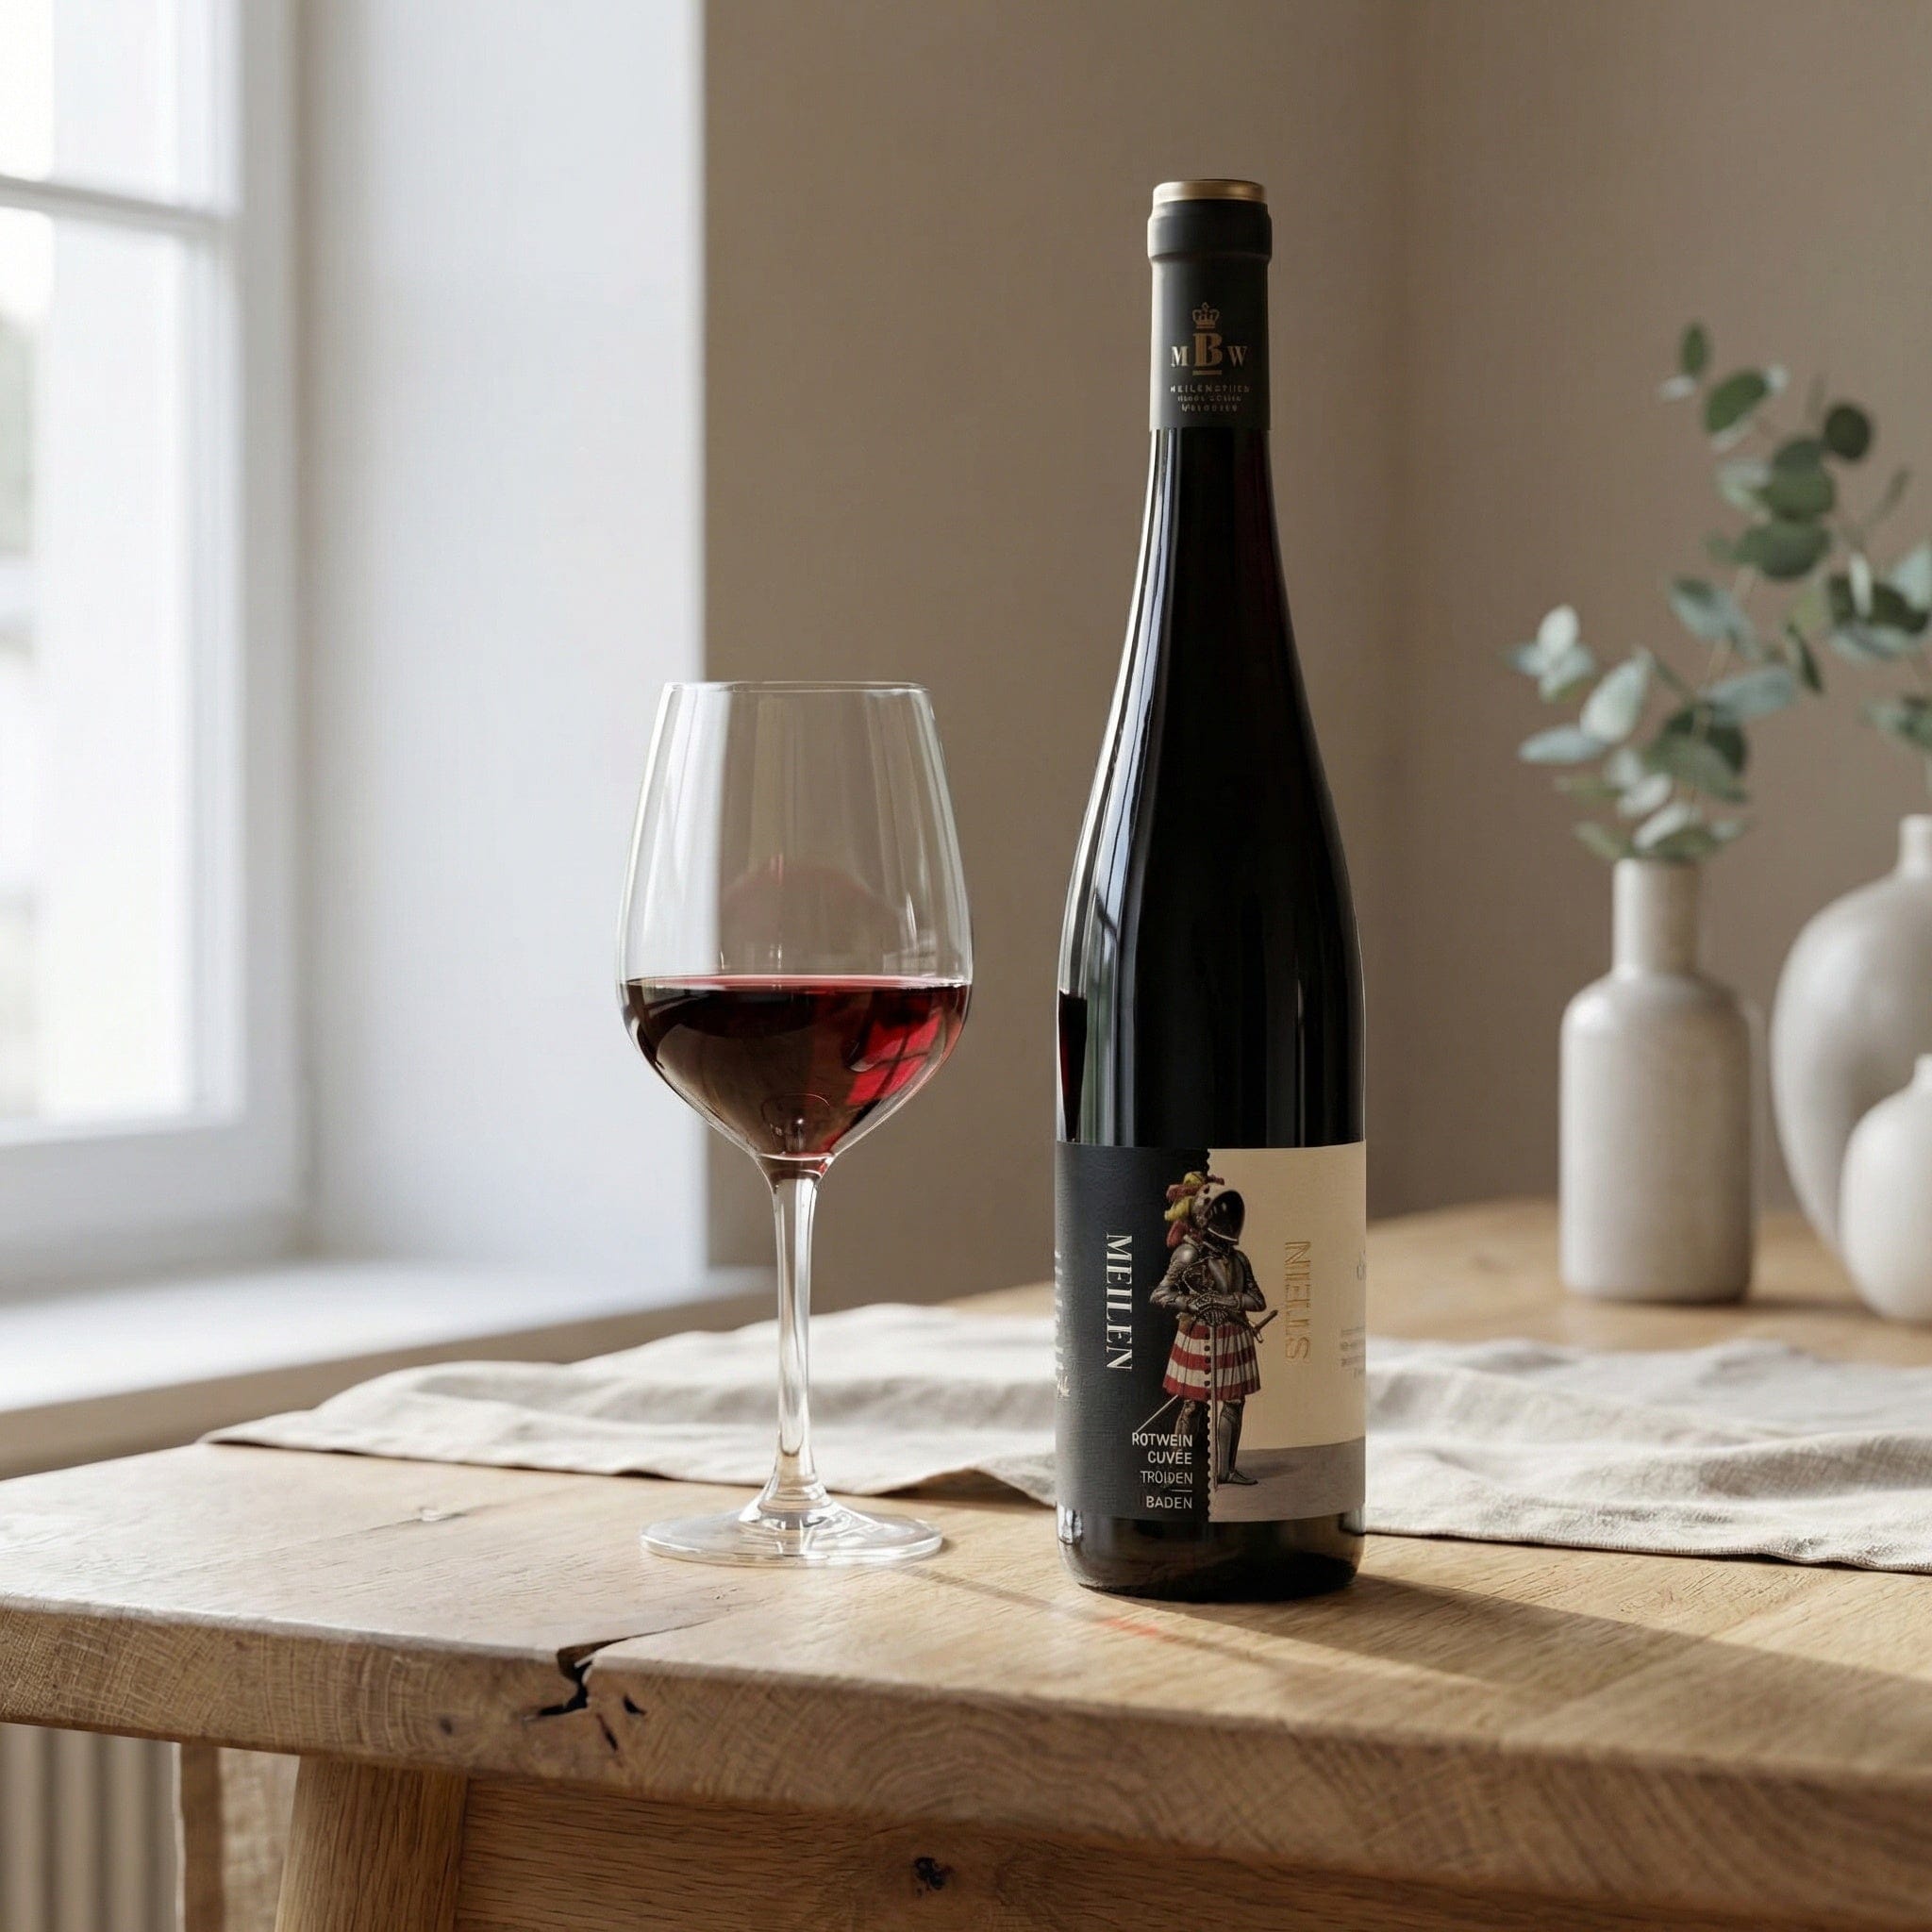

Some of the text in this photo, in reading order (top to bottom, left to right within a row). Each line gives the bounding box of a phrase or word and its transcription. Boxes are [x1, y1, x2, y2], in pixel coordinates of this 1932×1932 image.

[1106, 1232, 1133, 1370] MEILEN
[1132, 1432, 1193, 1447] ROTWEIN
[1147, 1449, 1192, 1465] CUVÉE
[1146, 1495, 1193, 1509] BADEN
